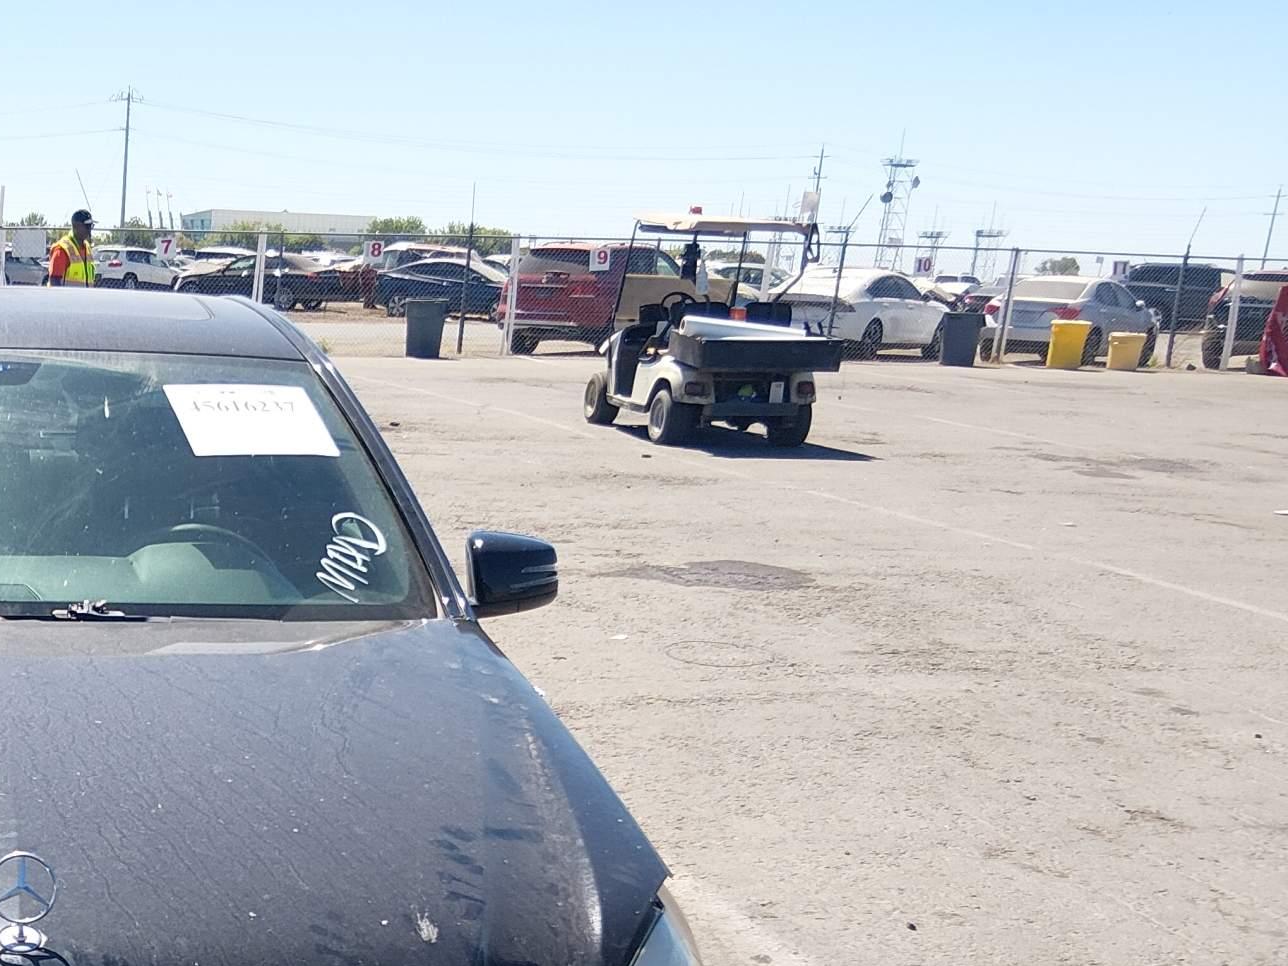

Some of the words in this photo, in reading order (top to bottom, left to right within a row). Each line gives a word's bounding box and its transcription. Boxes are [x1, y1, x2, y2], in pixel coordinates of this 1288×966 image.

[160, 239, 173, 255] 7
[370, 242, 383, 258] 8
[596, 250, 608, 265] 9
[916, 257, 932, 273] 10
